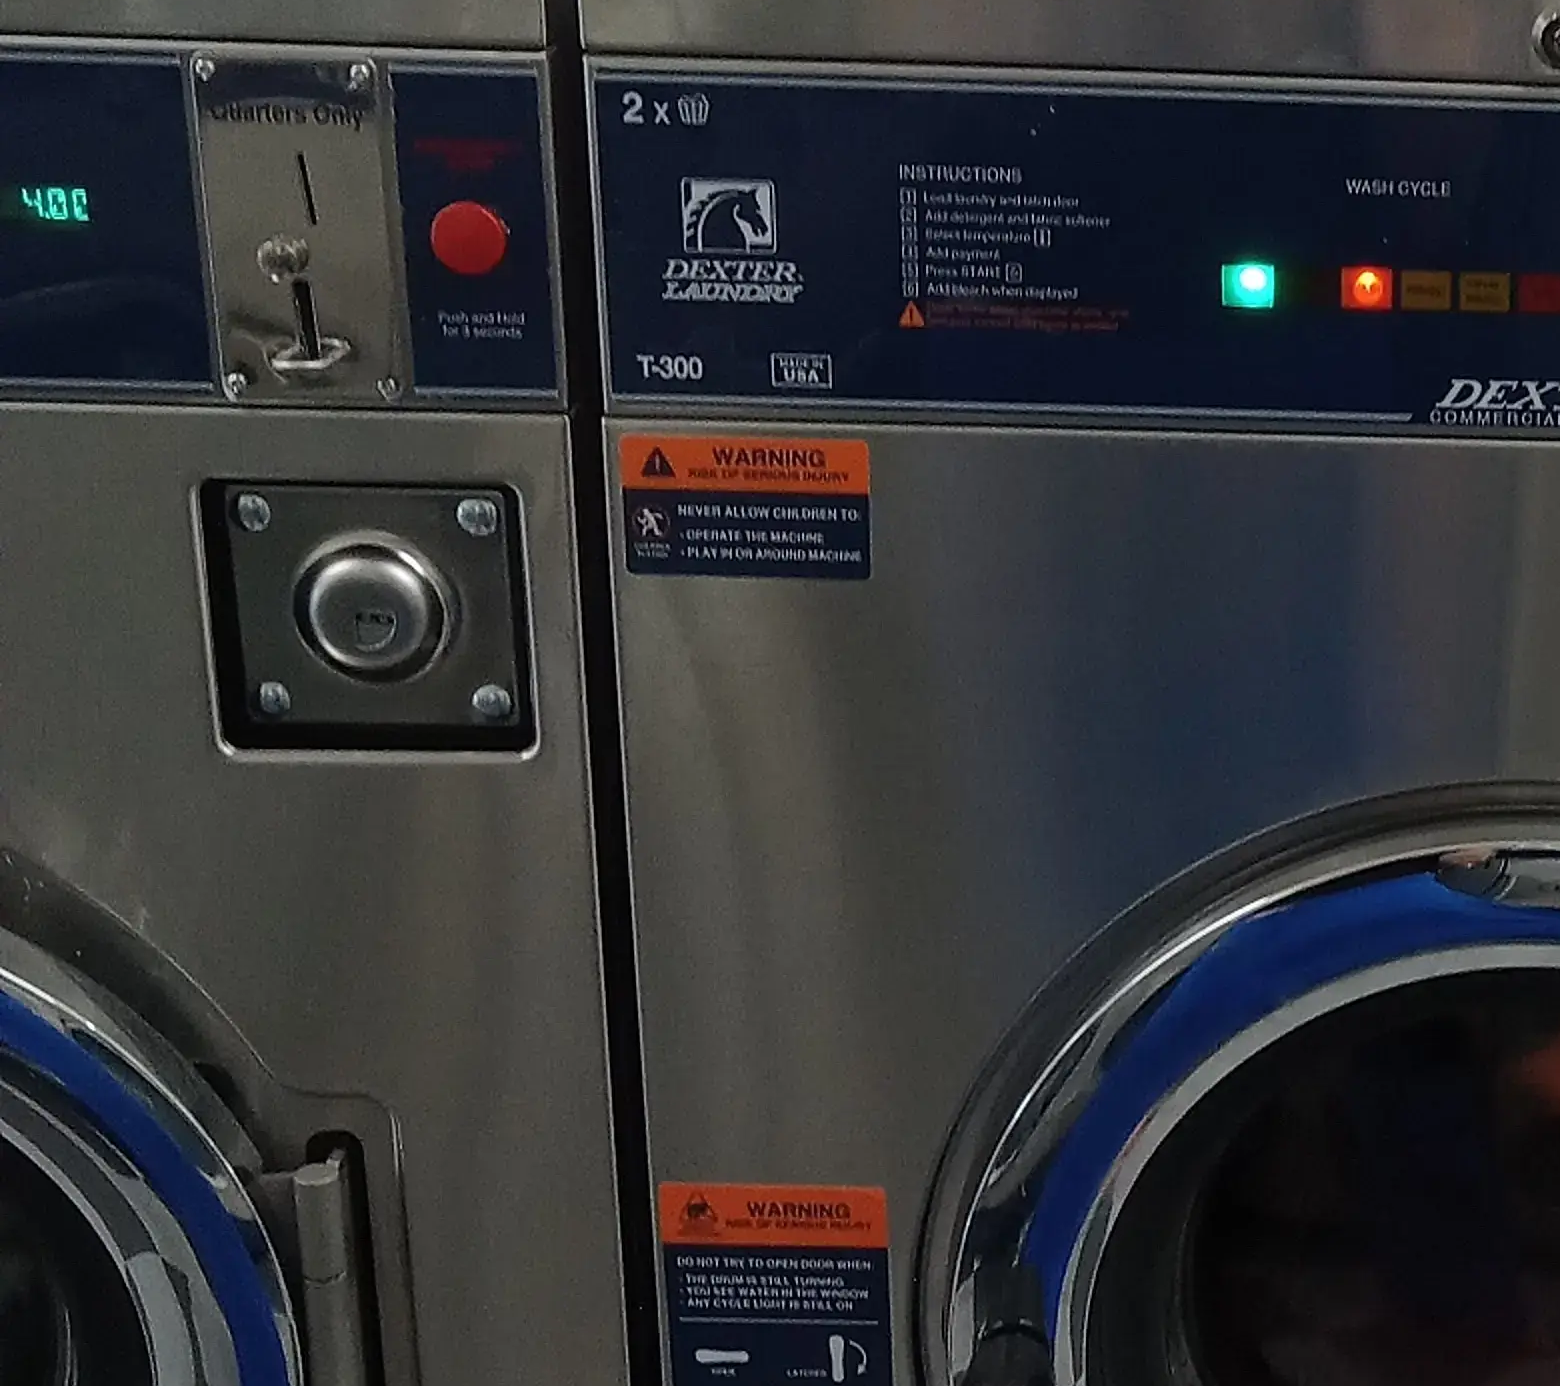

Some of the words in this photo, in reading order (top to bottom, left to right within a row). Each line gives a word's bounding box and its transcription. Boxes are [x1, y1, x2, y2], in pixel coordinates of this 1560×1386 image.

[313, 103, 364, 132] Only
[622, 91, 644, 124] 2
[653, 101, 671, 125] x
[899, 163, 1022, 184] INSTRUCTIONS
[1345, 178, 1394, 196] WASH
[1397, 180, 1451, 198] CYCLE
[662, 259, 803, 282] DEXTER
[662, 282, 805, 303] LAUNDRY
[438, 311, 469, 325] Push
[471, 311, 494, 325] and
[443, 324, 459, 337] for
[637, 354, 704, 380] T-300
[783, 367, 820, 383] USA
[712, 447, 827, 468] WARNING
[677, 504, 721, 518] NEVER
[725, 505, 771, 520] ALLOW
[772, 506, 838, 522] CHILDREN
[686, 528, 742, 543] OPERATE
[745, 529, 769, 544] THE
[770, 530, 826, 545] MACHINE
[687, 545, 718, 560] PLAY
[755, 547, 806, 562] AROUND
[808, 548, 862, 563] MACHINE
[747, 1201, 852, 1219] WARNING
